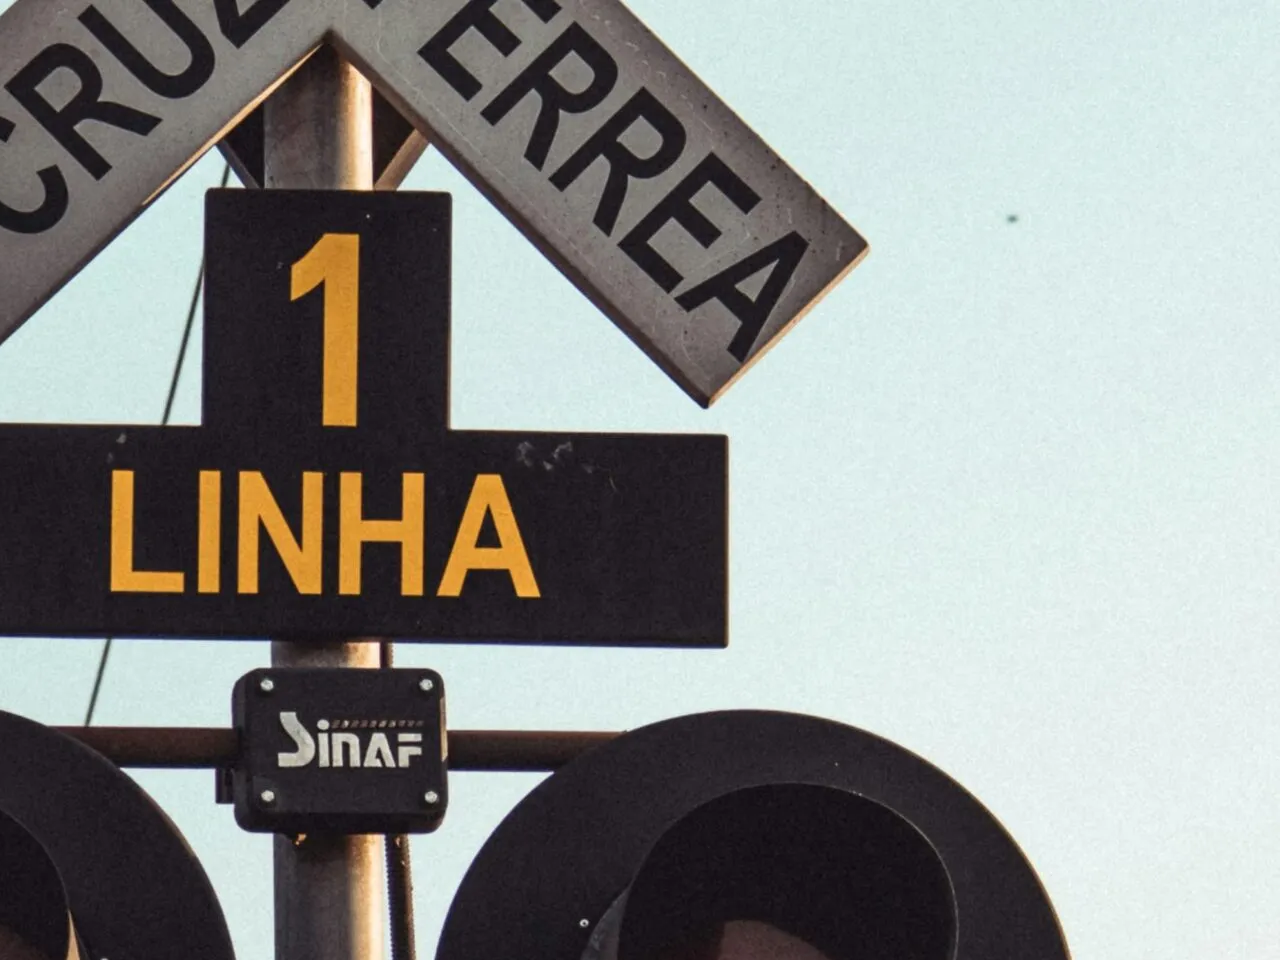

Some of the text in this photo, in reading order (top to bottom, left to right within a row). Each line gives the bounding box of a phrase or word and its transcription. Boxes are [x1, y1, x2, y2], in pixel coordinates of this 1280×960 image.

[361, 0, 810, 364] ERREA
[289, 232, 360, 427] 1
[109, 469, 542, 598] LINHA
